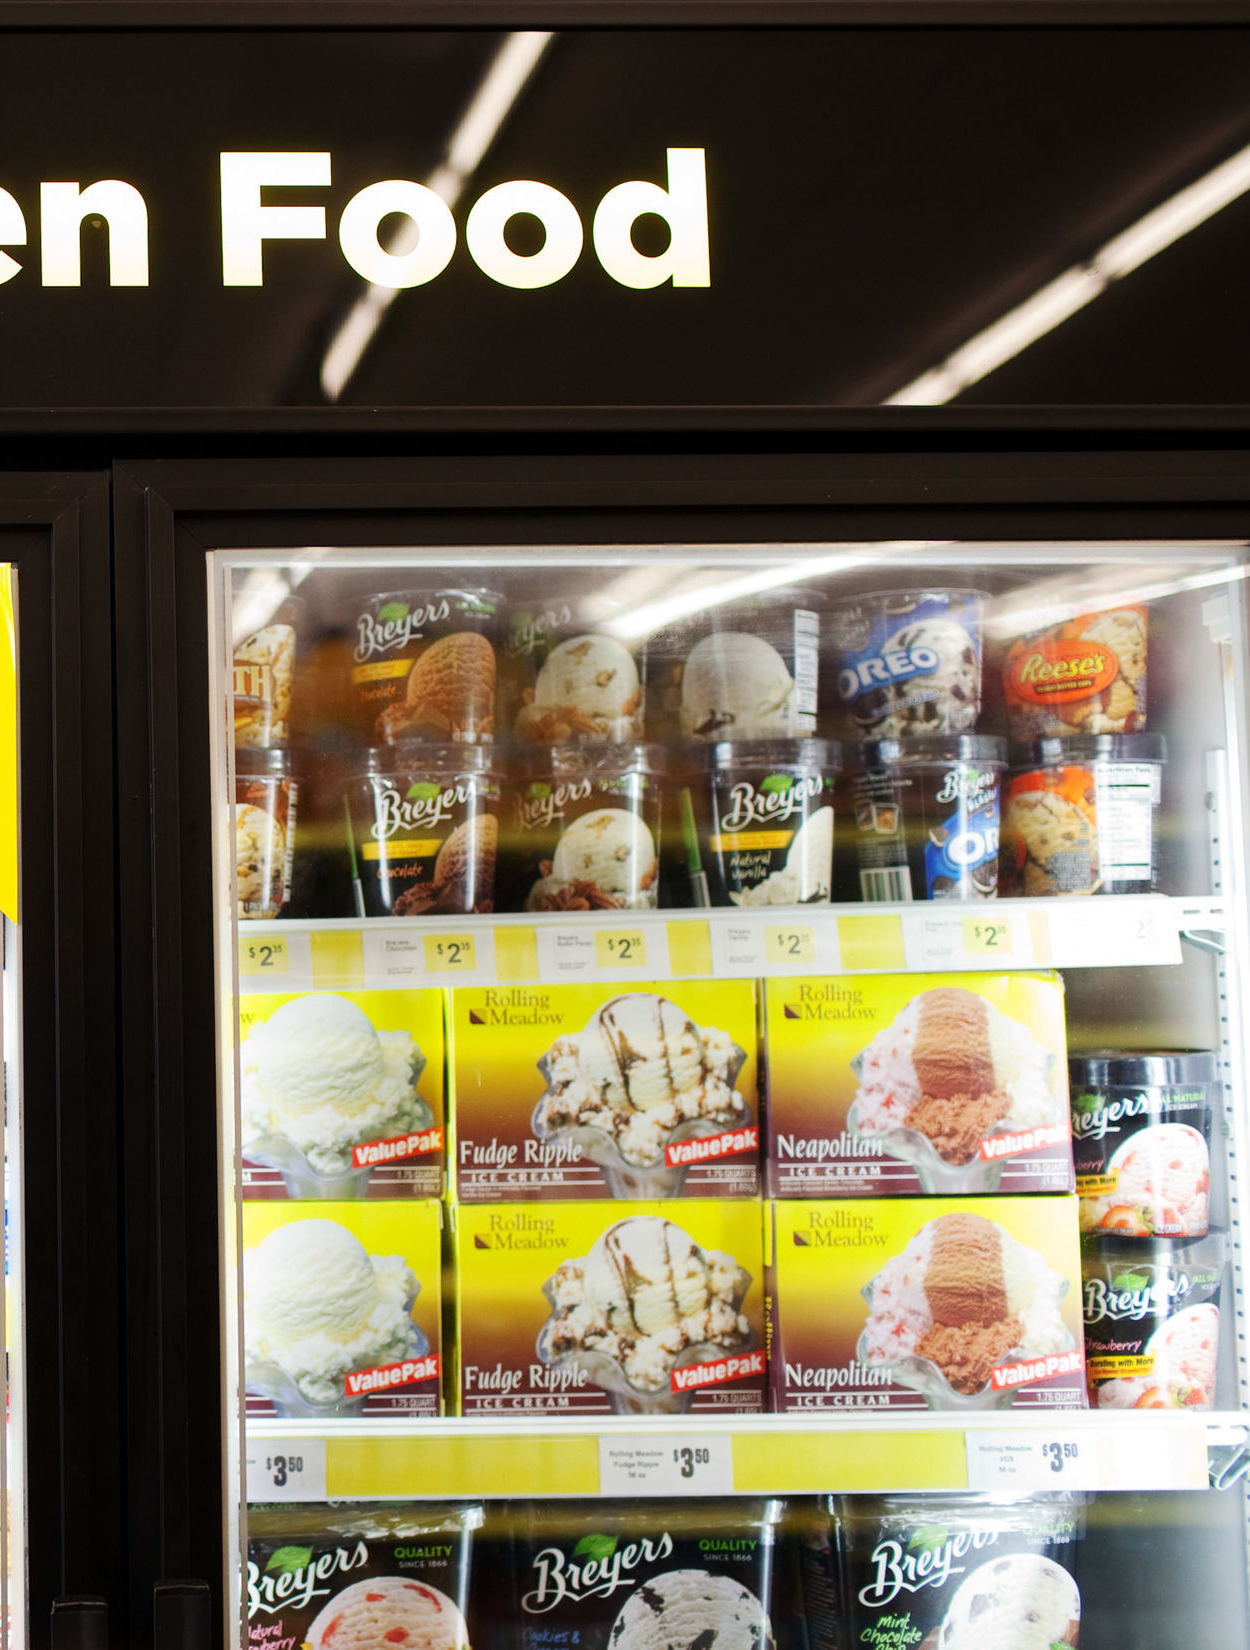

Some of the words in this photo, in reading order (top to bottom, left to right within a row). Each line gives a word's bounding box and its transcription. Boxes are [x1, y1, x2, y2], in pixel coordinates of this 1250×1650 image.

[220, 147, 710, 290] Food
[354, 600, 450, 663] Breyers
[1020, 652, 1106, 684] Reese's
[371, 784, 475, 840] Breyers
[520, 777, 591, 830] reyers
[721, 774, 824, 832] Breyers
[948, 827, 999, 865] OR
[730, 851, 771, 867] Natural
[377, 863, 423, 879] Cocolate
[484, 989, 550, 1009] Rolling
[799, 985, 863, 1003] Rolling
[489, 1009, 565, 1026] Meadow
[802, 1003, 877, 1020] Meadow
[1072, 1093, 1149, 1140] reyers
[356, 1130, 442, 1167] ValuePak
[669, 1130, 757, 1166] ValuePak
[777, 1134, 883, 1162] Neapolitan
[982, 1125, 1070, 1159] ValuePak
[460, 1138, 517, 1169] Fudge
[524, 1136, 583, 1168] Ripple
[471, 1172, 500, 1183] ICE
[507, 1171, 565, 1183] CREAM
[789, 1167, 817, 1176] ICE
[826, 1166, 882, 1175] CREAM
[489, 1214, 556, 1234] Rolling
[809, 1212, 874, 1231] Rolling
[495, 1233, 570, 1250] Meadow
[814, 1230, 888, 1247] Meadow
[1084, 1337, 1142, 1353] Strawberry
[674, 1354, 762, 1389] ValuePak
[994, 1354, 1081, 1387] ValuePak
[1118, 1359, 1134, 1367] with
[348, 1358, 437, 1393] ValuePak
[464, 1365, 522, 1394] Fudge
[529, 1363, 588, 1391] Ripple
[785, 1362, 893, 1391] Neapolitan
[477, 1398, 503, 1407] ICE
[513, 1397, 569, 1407] CREAM
[796, 1396, 823, 1406] ICE
[833, 1396, 890, 1405] CREAM
[1037, 1393, 1053, 1402] 1.75
[1055, 1392, 1081, 1402] QUART
[1023, 1522, 1075, 1536] QUALITY
[698, 1539, 758, 1551] QUALITY
[1052, 1536, 1070, 1544] 1866
[394, 1545, 453, 1559] QUALITY
[703, 1553, 730, 1561] SINCE
[732, 1553, 752, 1561] 1866
[427, 1559, 448, 1567] 1866
[521, 1531, 674, 1614] Breyers
[858, 1528, 999, 1608] Breyers
[239, 1540, 369, 1619] Breyers
[877, 1612, 910, 1629] Mint
[522, 1627, 568, 1643] Cookies
[860, 1627, 923, 1645] Chocolate
